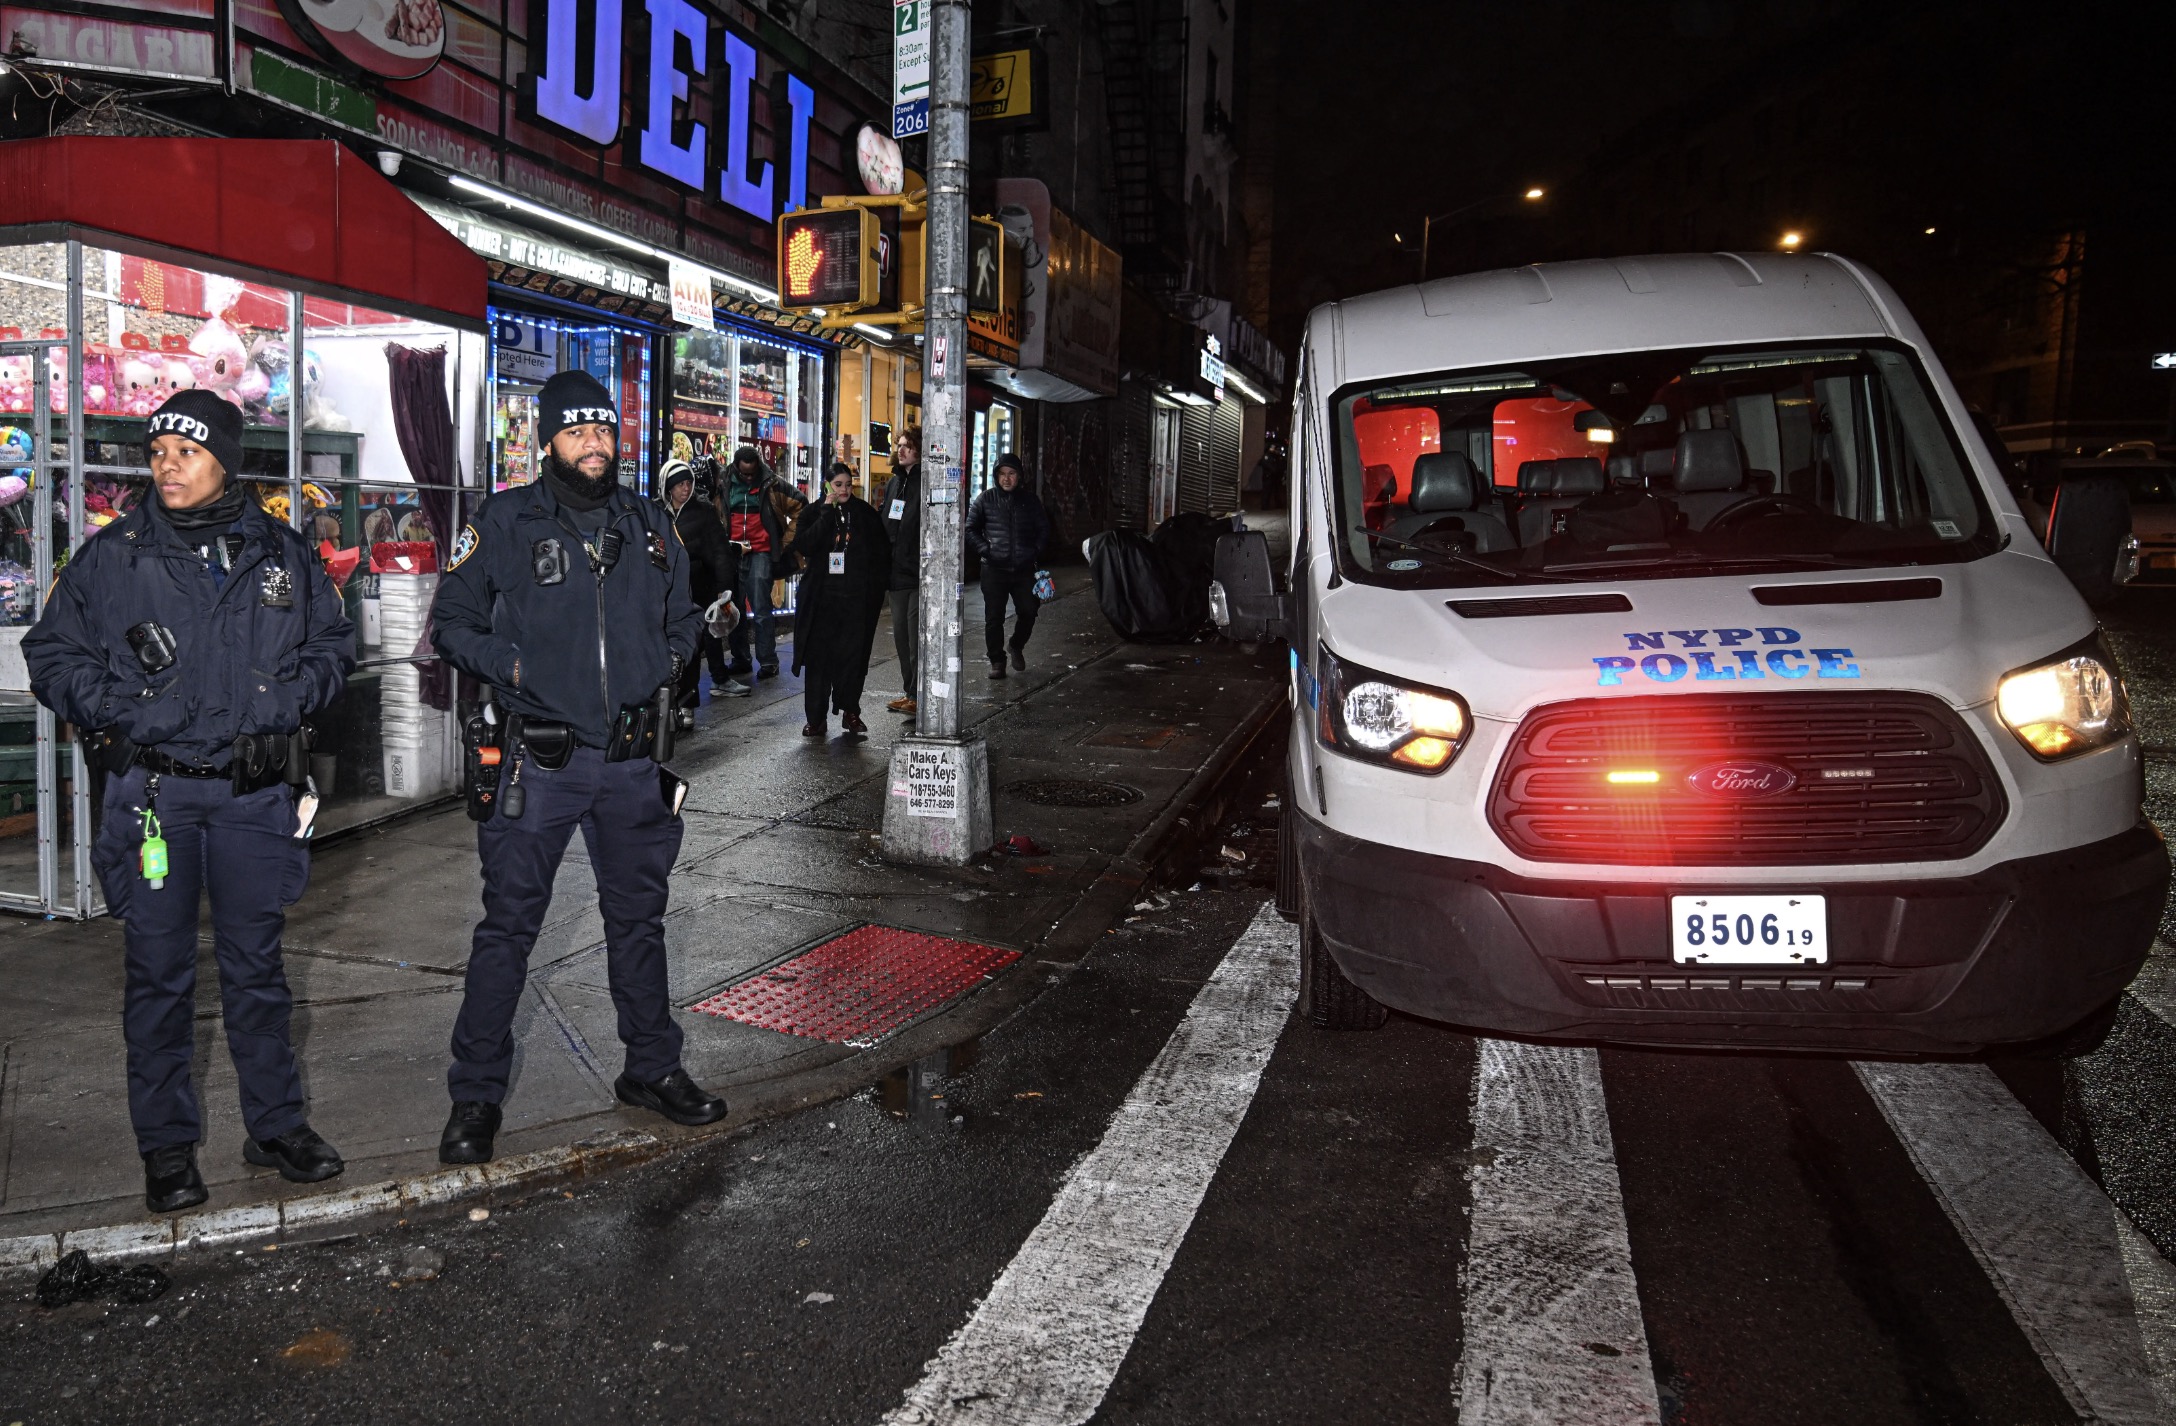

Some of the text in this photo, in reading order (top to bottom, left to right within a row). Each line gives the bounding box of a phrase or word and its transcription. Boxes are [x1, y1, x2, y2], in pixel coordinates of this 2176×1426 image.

[901, 4, 913, 32] 2
[899, 43, 923, 57] 8:30am
[899, 55, 921, 69] Except
[537, 0, 814, 223] DELI
[376, 113, 428, 155] SODAS
[437, 138, 465, 172] HOT
[520, 170, 593, 216] SANDWICHES
[600, 202, 638, 234] COFFEE
[467, 224, 502, 256] DINNER
[510, 238, 528, 263] HOT
[611, 269, 631, 293] COLD
[630, 275, 648, 298] CUTS
[674, 279, 709, 307] ATM
[523, 354, 545, 369] Here
[562, 407, 617, 424] NYPD
[149, 413, 209, 441] NYPD
[1623, 627, 1802, 650] NYPD
[1592, 648, 1861, 686] POLICE
[910, 751, 937, 764] Make
[908, 764, 956, 784] Cars Keys
[1712, 768, 1770, 790] Ford
[909, 783, 955, 797] 718-755-3460
[909, 798, 955, 809] 646-577-8299
[1687, 913, 1814, 946] 8506 19
